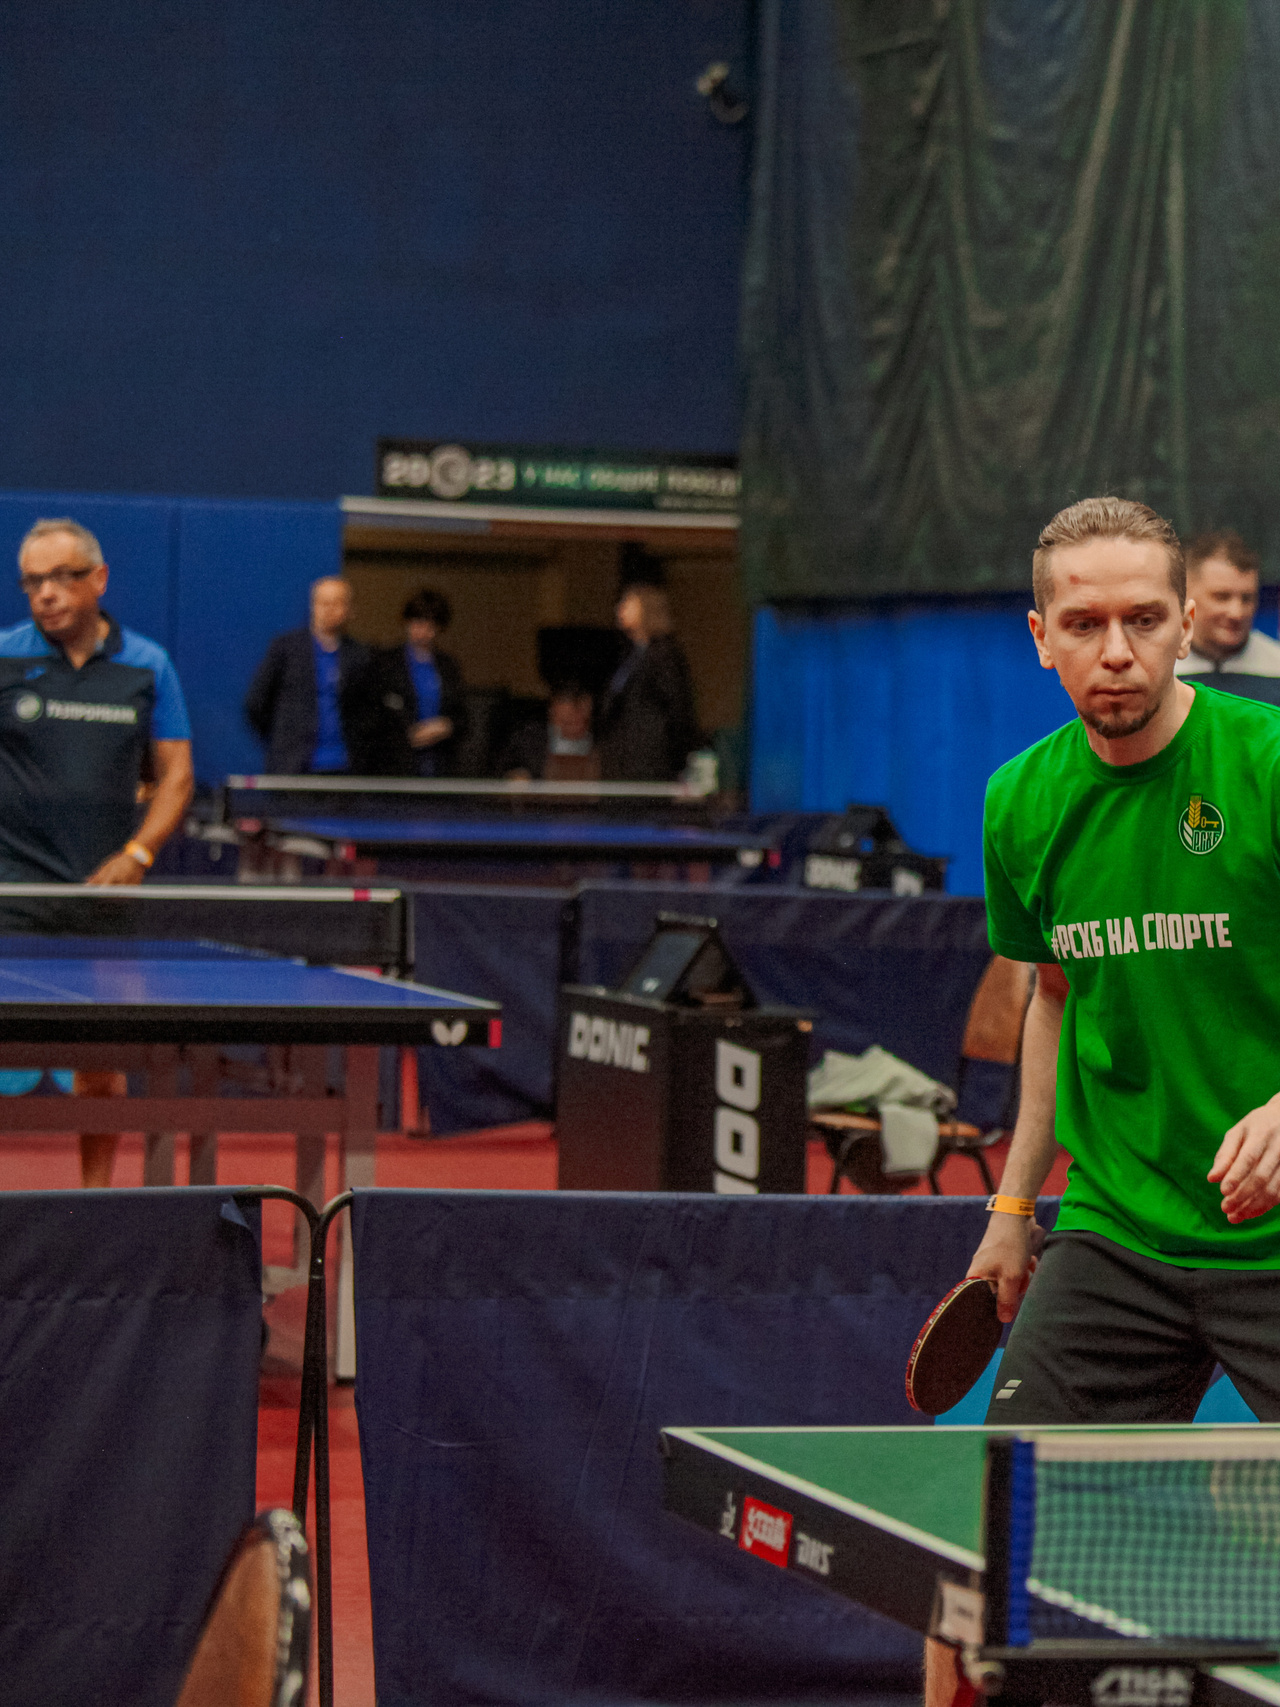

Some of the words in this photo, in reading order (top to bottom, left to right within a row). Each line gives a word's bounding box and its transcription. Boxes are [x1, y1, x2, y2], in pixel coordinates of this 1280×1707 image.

[1105, 906, 1140, 956] НА
[1142, 902, 1233, 951] СПОРТЕ
[568, 1011, 651, 1074] DONIC
